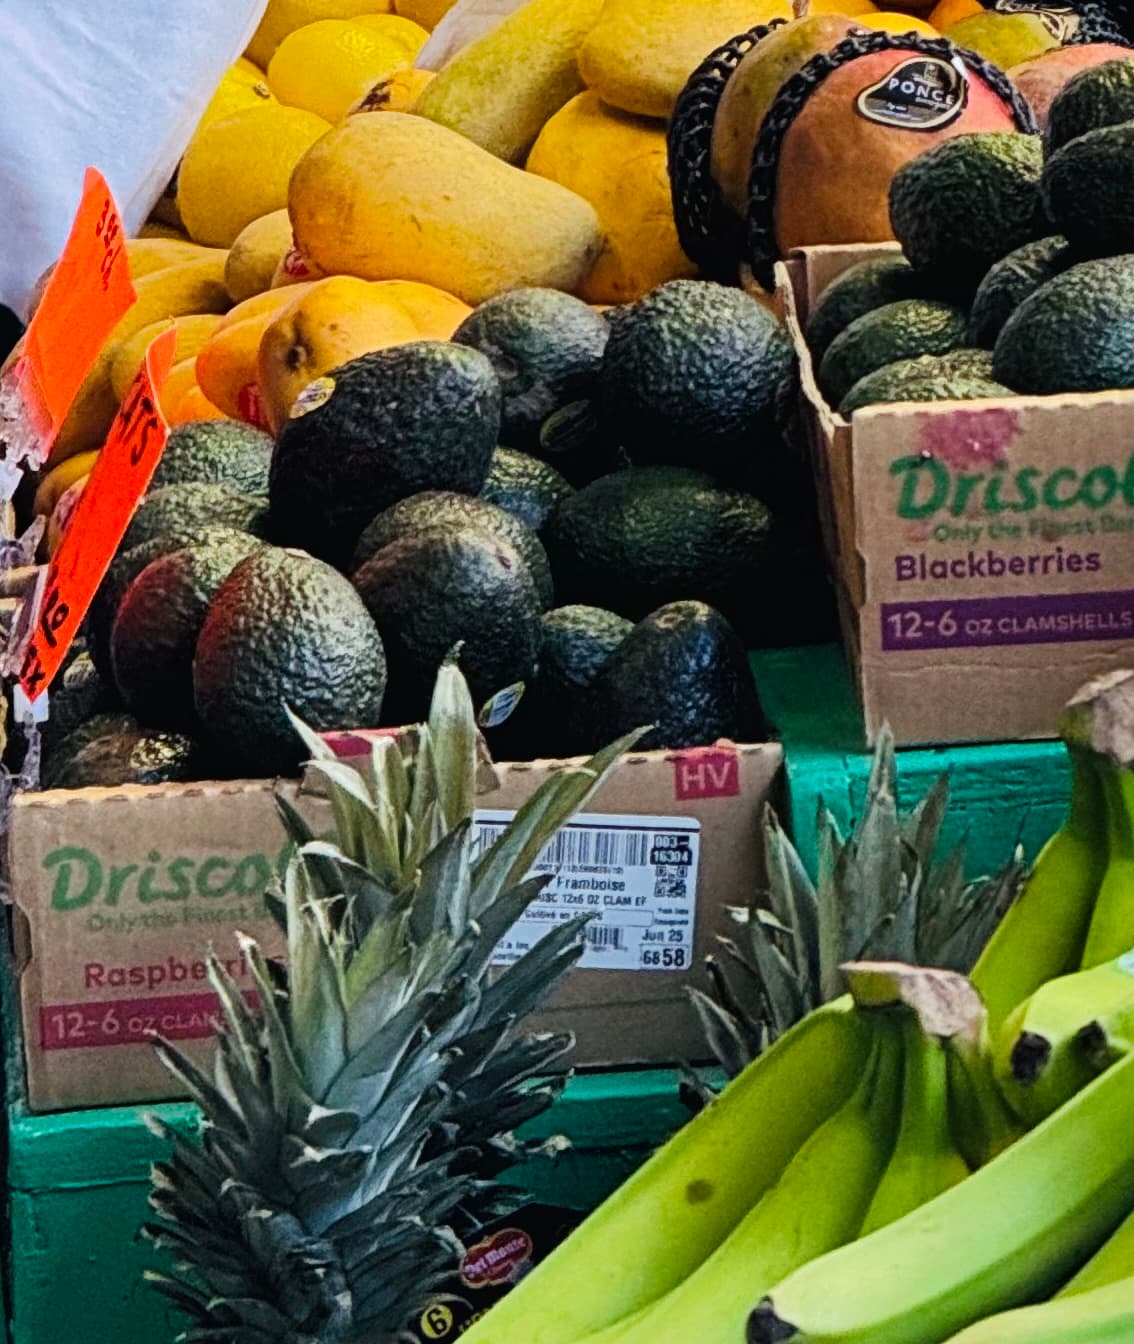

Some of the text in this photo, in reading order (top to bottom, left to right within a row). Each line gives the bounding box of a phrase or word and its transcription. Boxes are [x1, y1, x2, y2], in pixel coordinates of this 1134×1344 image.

[889, 78, 955, 104] PONCE
[895, 547, 1102, 581] Blackberries
[888, 611, 1133, 638] 12-6 OZ CLAMSHELLS
[682, 761, 731, 792] HV
[556, 875, 626, 891] Framboise
[563, 894, 584, 905] 12x6
[587, 895, 600, 905] OZ
[603, 896, 632, 906] CLAM
[642, 929, 684, 943] Jun 25
[52, 1009, 120, 1040] 12-6
[426, 1307, 447, 1335] 6
